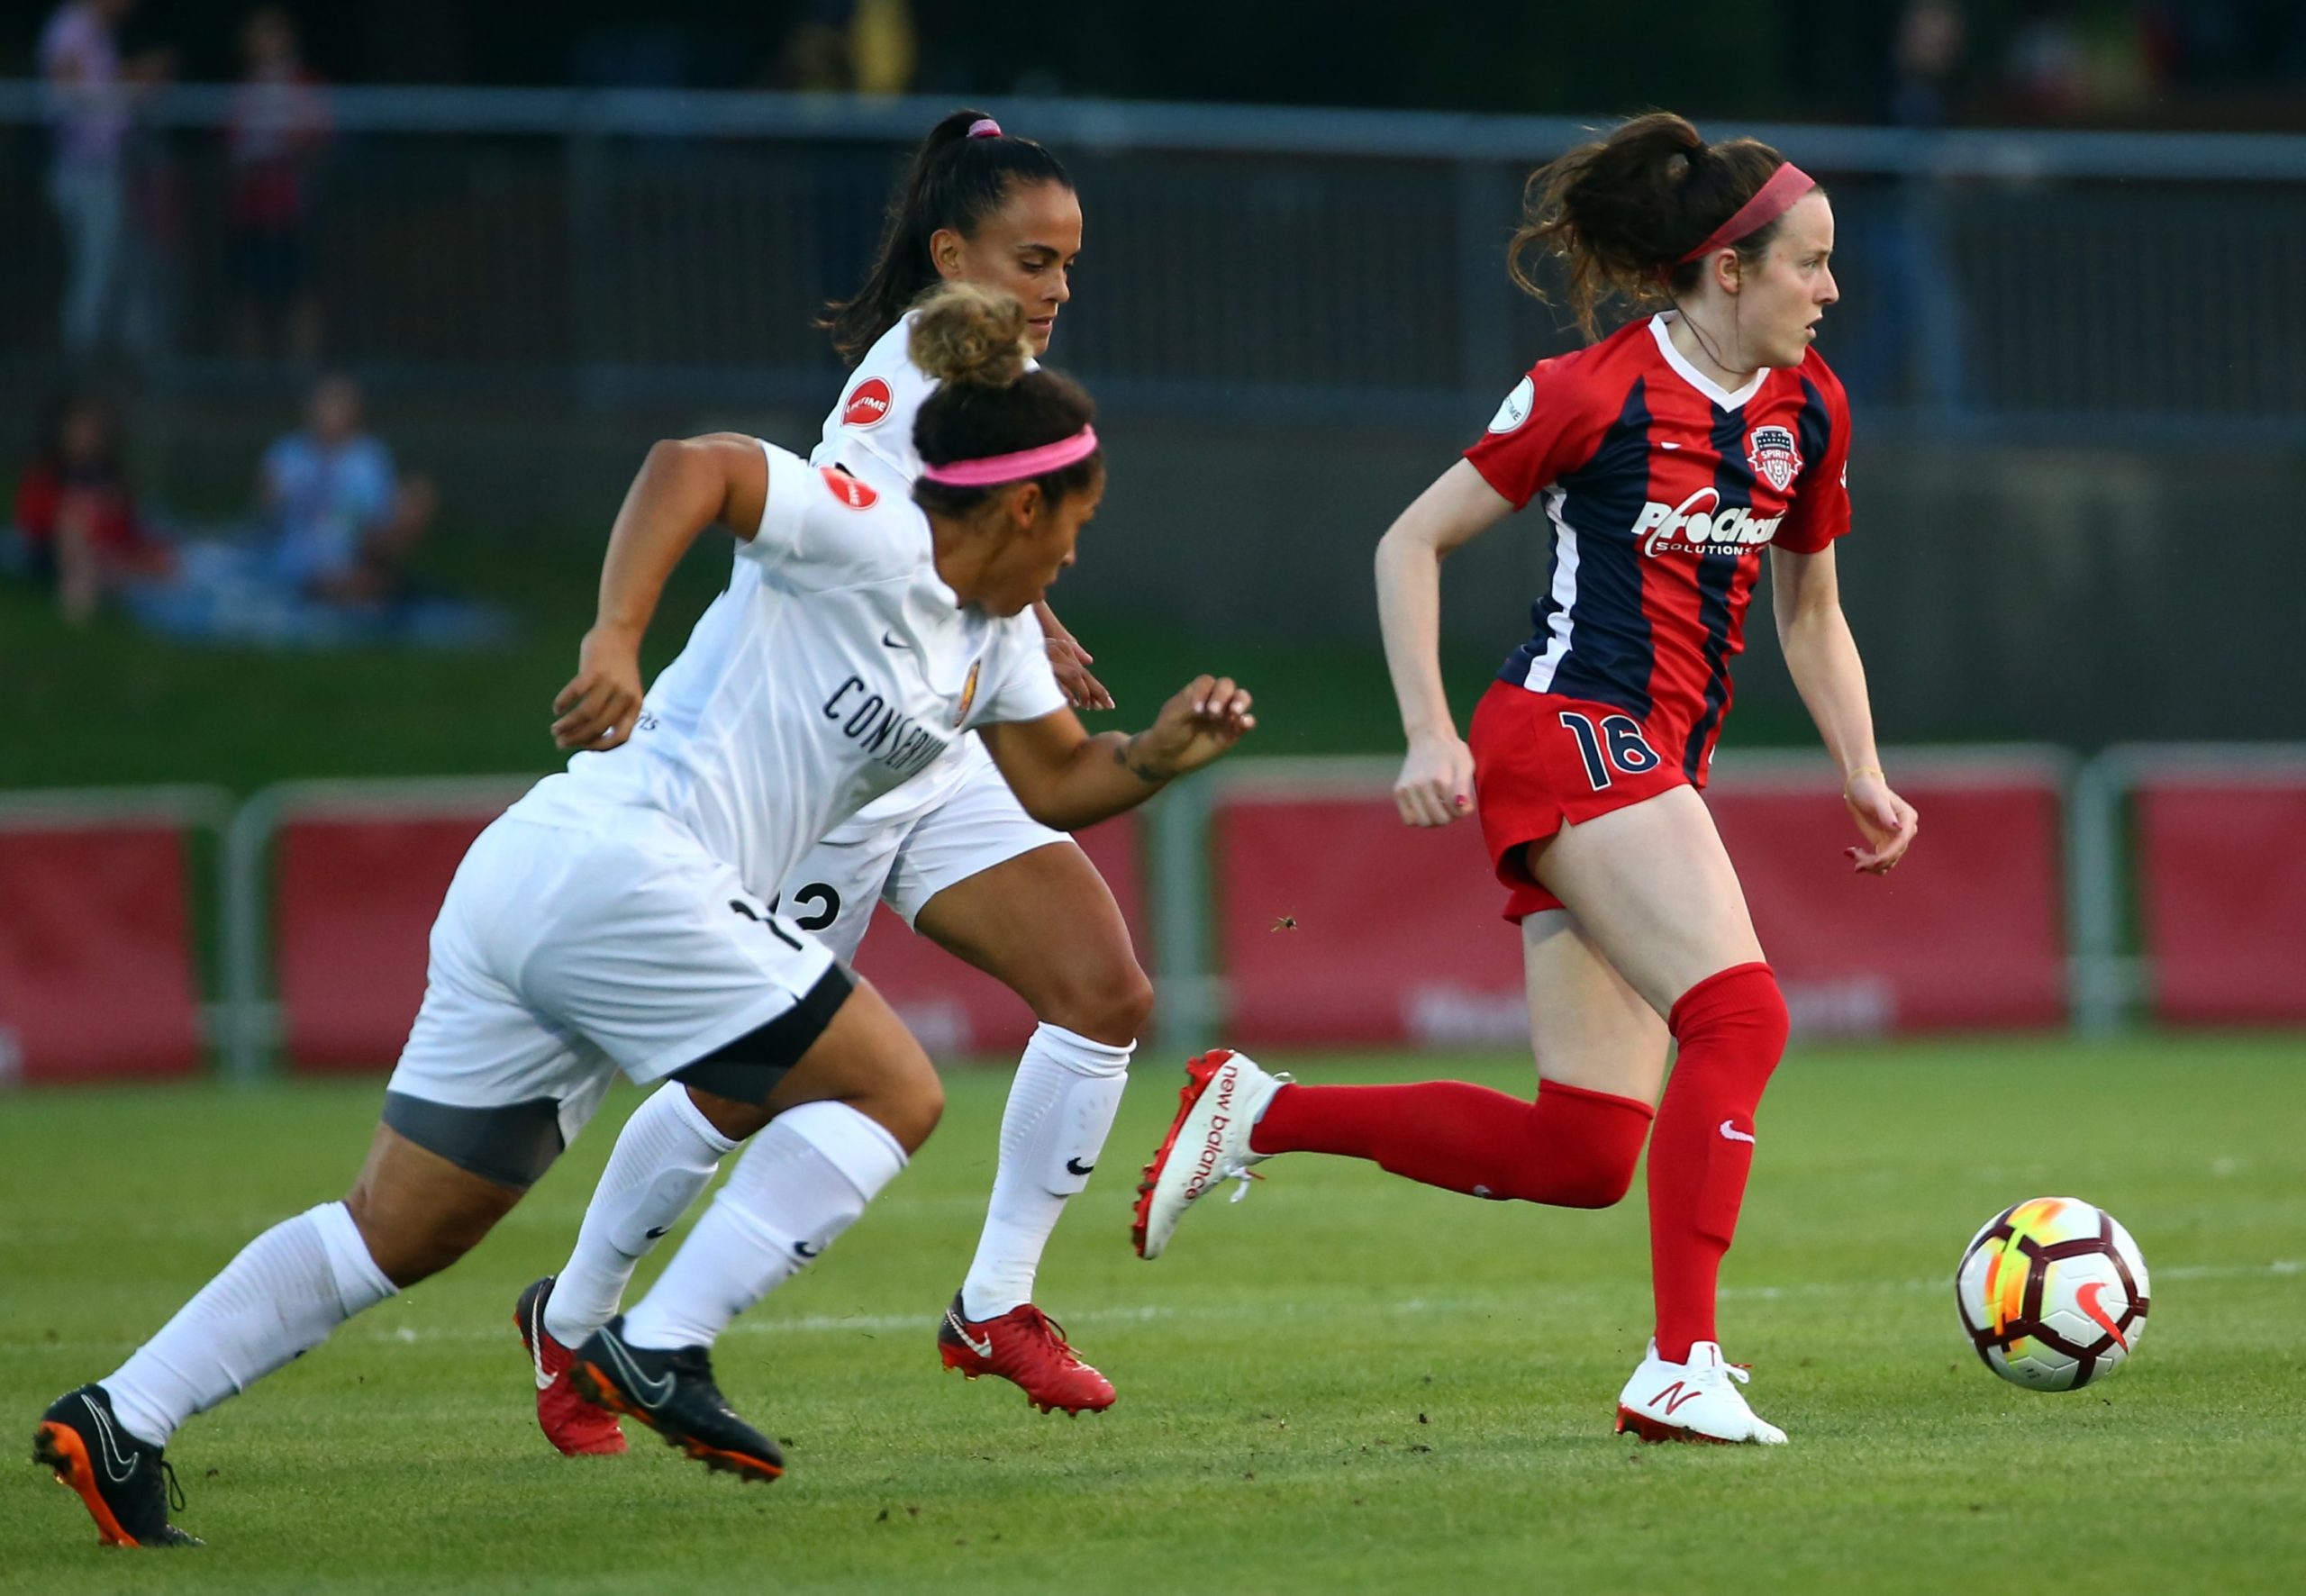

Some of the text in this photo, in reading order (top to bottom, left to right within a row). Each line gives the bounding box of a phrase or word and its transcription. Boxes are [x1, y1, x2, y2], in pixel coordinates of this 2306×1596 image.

[1761, 449, 1790, 460] SPIRIT
[1558, 711, 1661, 792] 16
[1184, 1065, 1238, 1201] new balance
